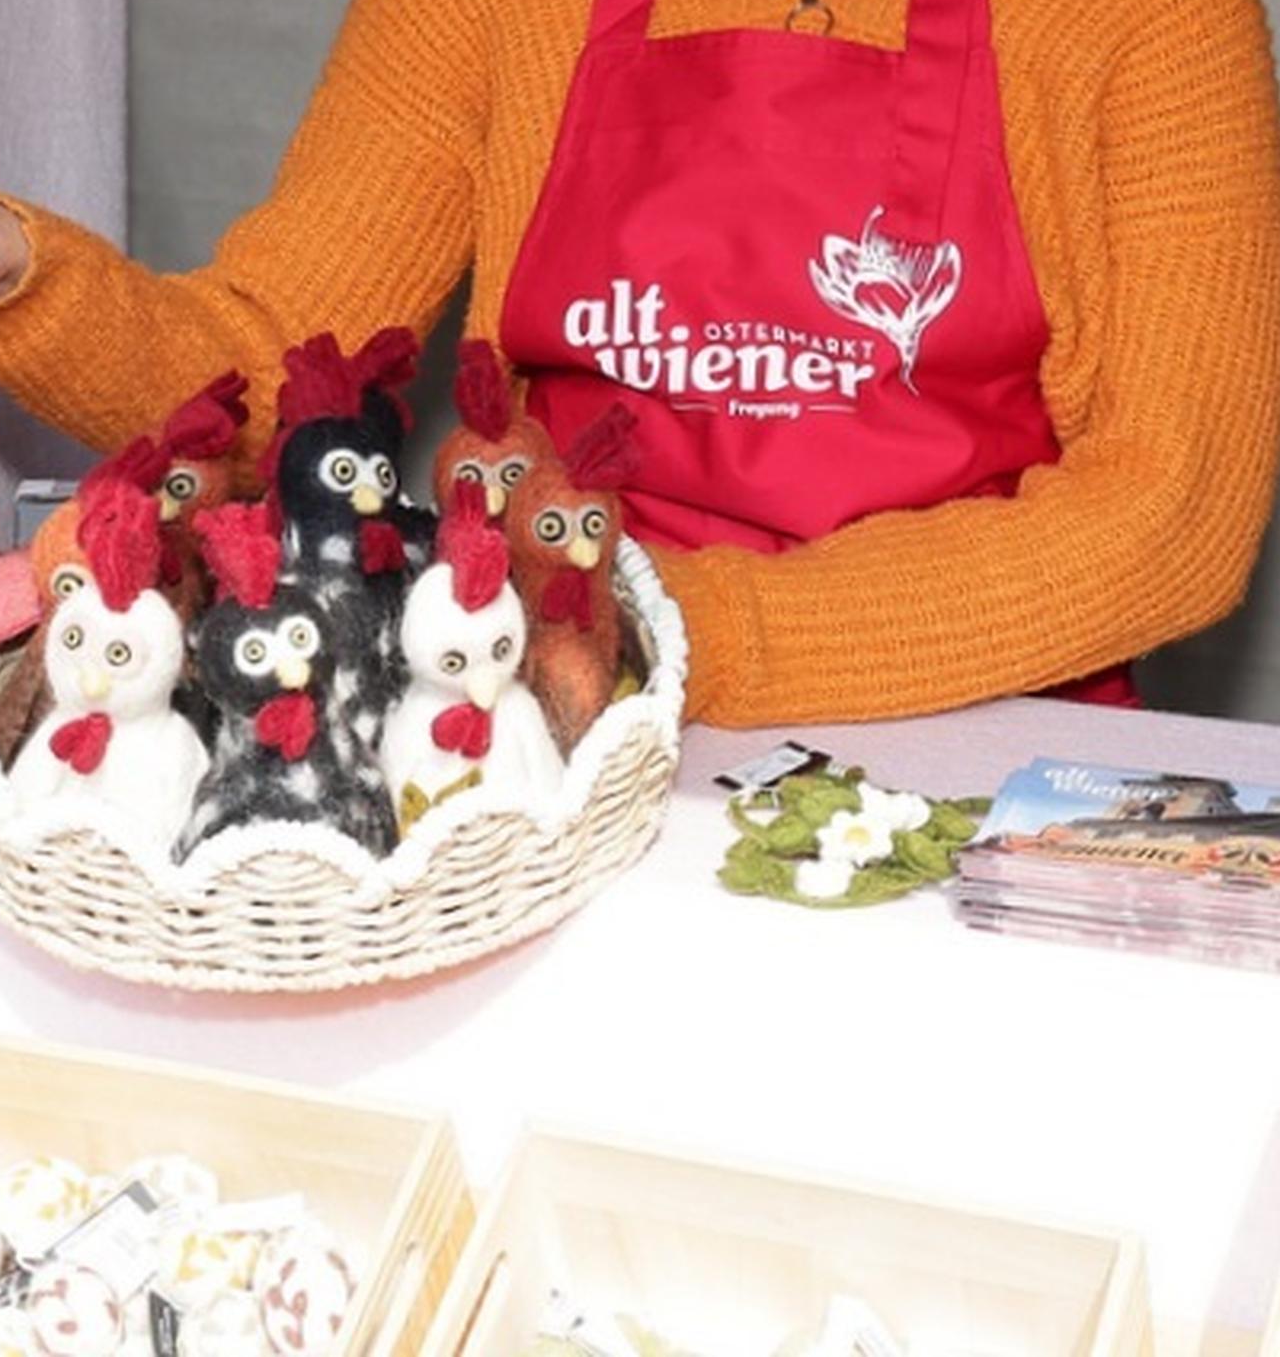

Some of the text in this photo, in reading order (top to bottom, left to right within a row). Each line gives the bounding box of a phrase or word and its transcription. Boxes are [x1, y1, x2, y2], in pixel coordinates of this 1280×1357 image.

[564, 279, 666, 347] alt
[704, 322, 875, 359] OSTERMARKT
[594, 327, 875, 398] wiener
